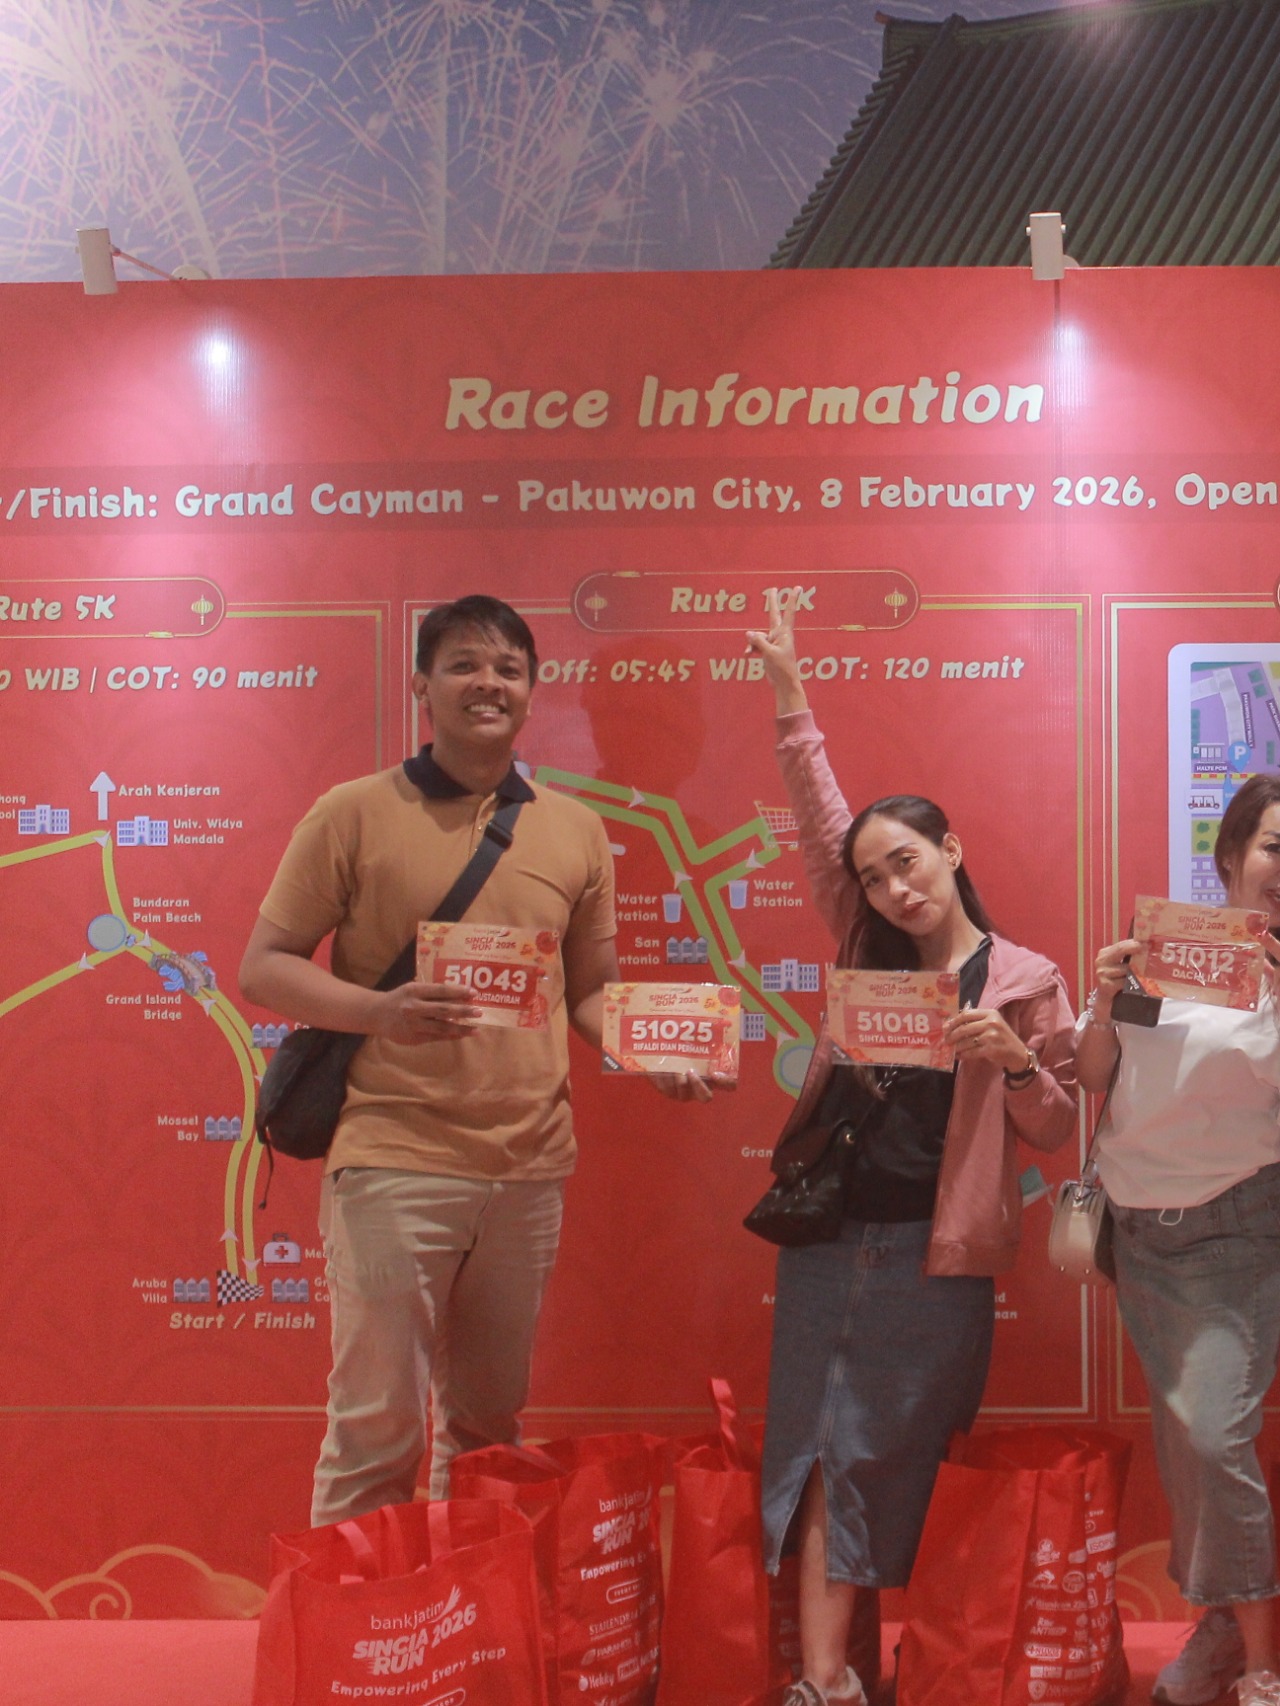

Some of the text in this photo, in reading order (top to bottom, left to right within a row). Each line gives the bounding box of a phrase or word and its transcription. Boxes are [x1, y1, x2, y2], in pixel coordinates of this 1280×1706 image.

[444, 370, 1043, 430] Race Information
[0, 486, 158, 521] /Finish:
[175, 483, 294, 519] Grand
[310, 482, 464, 518] Cayman
[482, 494, 500, 504] -
[518, 479, 695, 513] Pakuwon
[713, 477, 801, 513] City,
[820, 479, 842, 508] 8
[860, 476, 1036, 511] February
[1052, 475, 1157, 510] 2026,
[1174, 473, 1278, 510] Open
[670, 587, 747, 613] Rute
[0, 594, 117, 621] Rute 5K
[537, 655, 1025, 684] Off: 05:45 WIB COT: 120 menit
[25, 667, 79, 691] WIB
[107, 666, 179, 691] COT:
[191, 666, 226, 690] 90
[237, 664, 318, 689] menit
[118, 784, 221, 798] Arah Kenjeran
[173, 818, 243, 831] Univ. Widya
[173, 833, 225, 845] Mandala
[753, 879, 795, 892] Water
[132, 897, 190, 908] Bundaran
[617, 893, 658, 905] Water
[753, 896, 803, 908] Station
[132, 912, 202, 924] Palm Beach
[614, 910, 658, 921] tation
[634, 936, 660, 948] San
[618, 953, 660, 965] ntonio
[1160, 943, 1235, 973] 51012
[444, 965, 527, 992] 51043
[106, 994, 182, 1006] Grand Island
[648, 994, 678, 1002] SINCIA
[678, 996, 699, 1004] 2026
[143, 1010, 182, 1022] Bridge
[857, 1011, 930, 1034] 51018
[630, 1019, 714, 1043] 51025
[660, 1044, 677, 1053] DIAN
[157, 1115, 199, 1126] Mossel
[177, 1131, 200, 1143] Bay
[132, 1278, 168, 1289] Aruba
[142, 1293, 168, 1304] Villa
[169, 1313, 226, 1330] Start
[253, 1312, 316, 1330] Finish
[593, 1511, 636, 1543] SINCIA
[602, 1527, 632, 1555] RUN
[370, 1599, 445, 1631] bankjatim
[352, 1602, 477, 1660] SINCIA 2026
[371, 1647, 424, 1676] RUN
[330, 1646, 507, 1698] Empowering Every Step
